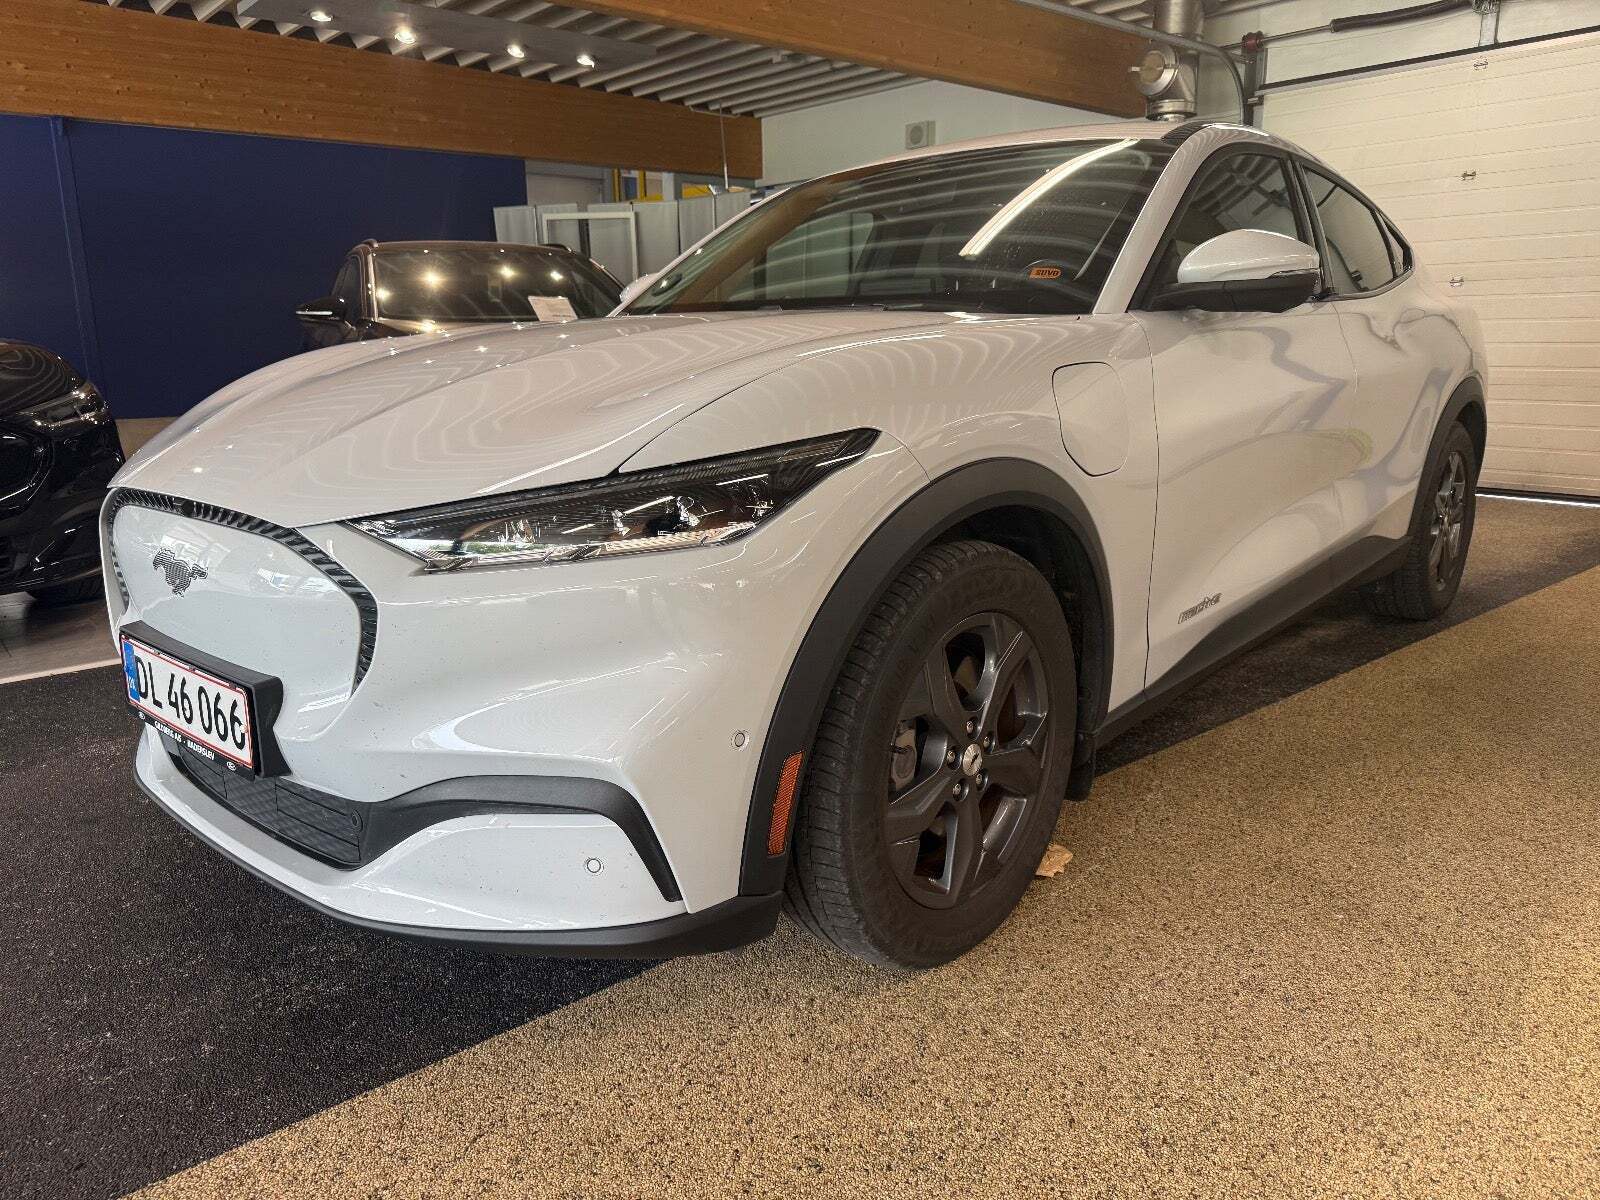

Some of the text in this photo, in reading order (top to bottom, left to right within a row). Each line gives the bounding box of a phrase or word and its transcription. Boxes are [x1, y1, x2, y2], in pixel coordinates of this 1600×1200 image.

[135, 655, 246, 750] DL 46 066
